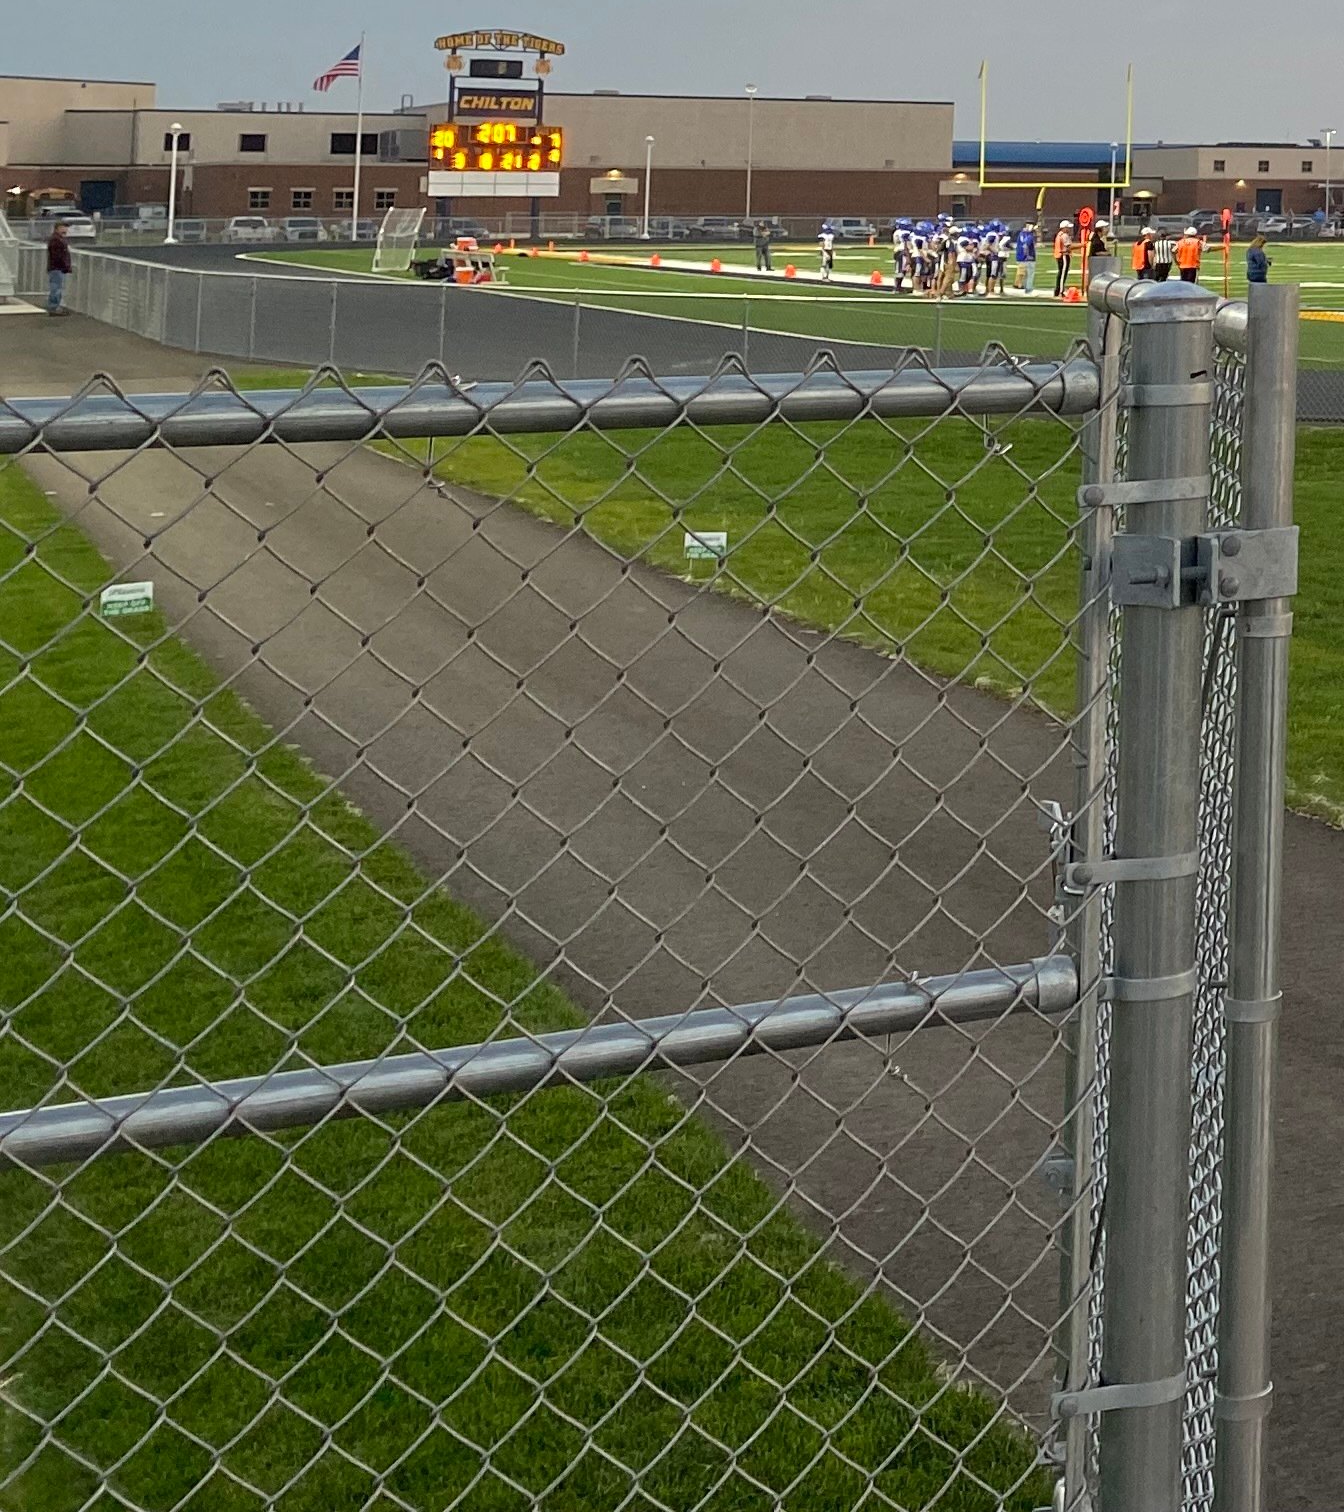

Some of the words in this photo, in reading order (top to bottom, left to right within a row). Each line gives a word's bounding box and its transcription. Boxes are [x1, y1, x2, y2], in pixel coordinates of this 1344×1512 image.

[438, 35, 473, 49] HOME
[477, 33, 491, 45] OF
[495, 33, 518, 46] THE
[523, 36, 564, 55] TIGERS
[460, 95, 534, 110] CHILTON
